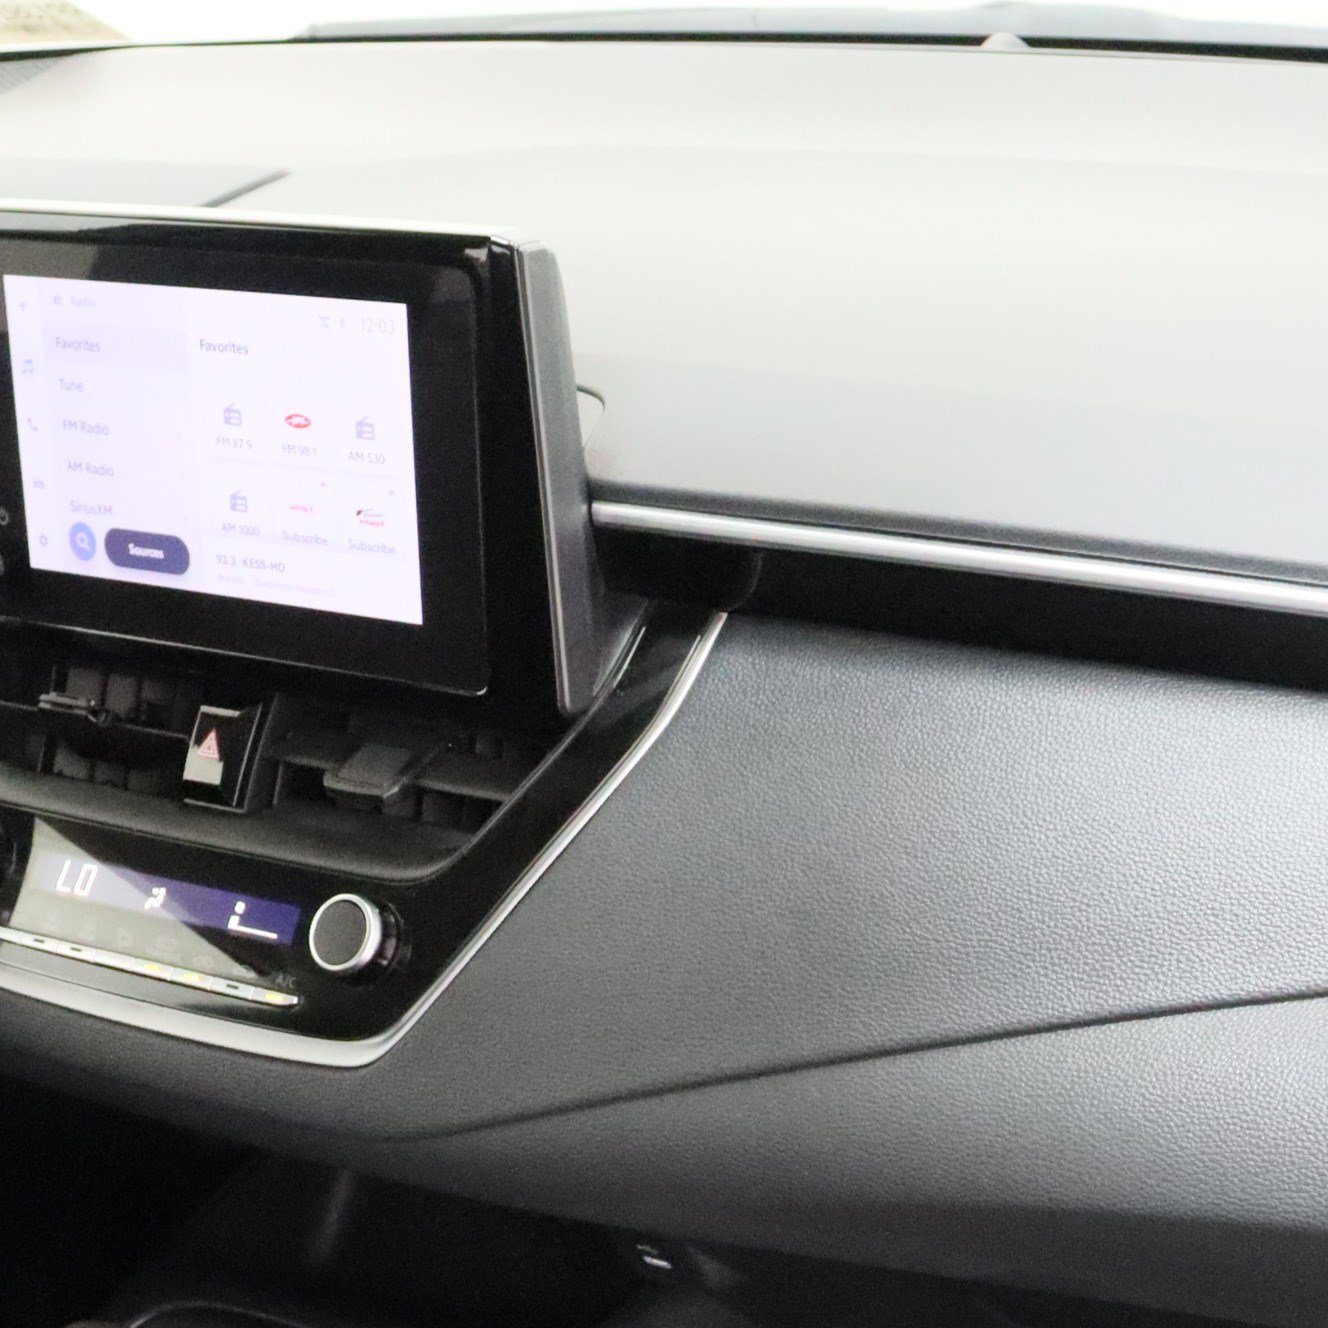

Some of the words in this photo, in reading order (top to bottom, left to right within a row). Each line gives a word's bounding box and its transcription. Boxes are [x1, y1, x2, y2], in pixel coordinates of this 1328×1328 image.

[360, 317, 396, 335] 12:03
[56, 336, 101, 352] Favorites
[199, 338, 249, 355] Favorites
[58, 377, 84, 392] Tune
[62, 419, 78, 432] FM
[80, 421, 110, 435] Radio
[216, 436, 231, 448] FM
[282, 443, 296, 455] FM
[348, 451, 364, 463] AM
[366, 453, 386, 465] 530
[66, 460, 83, 472] AM
[85, 462, 114, 477] Radio
[70, 500, 113, 516] SiriusXM
[221, 522, 236, 533] AM
[282, 530, 329, 546] Subscribe
[348, 538, 396, 555] Subscribe
[56, 859, 98, 896] LO
